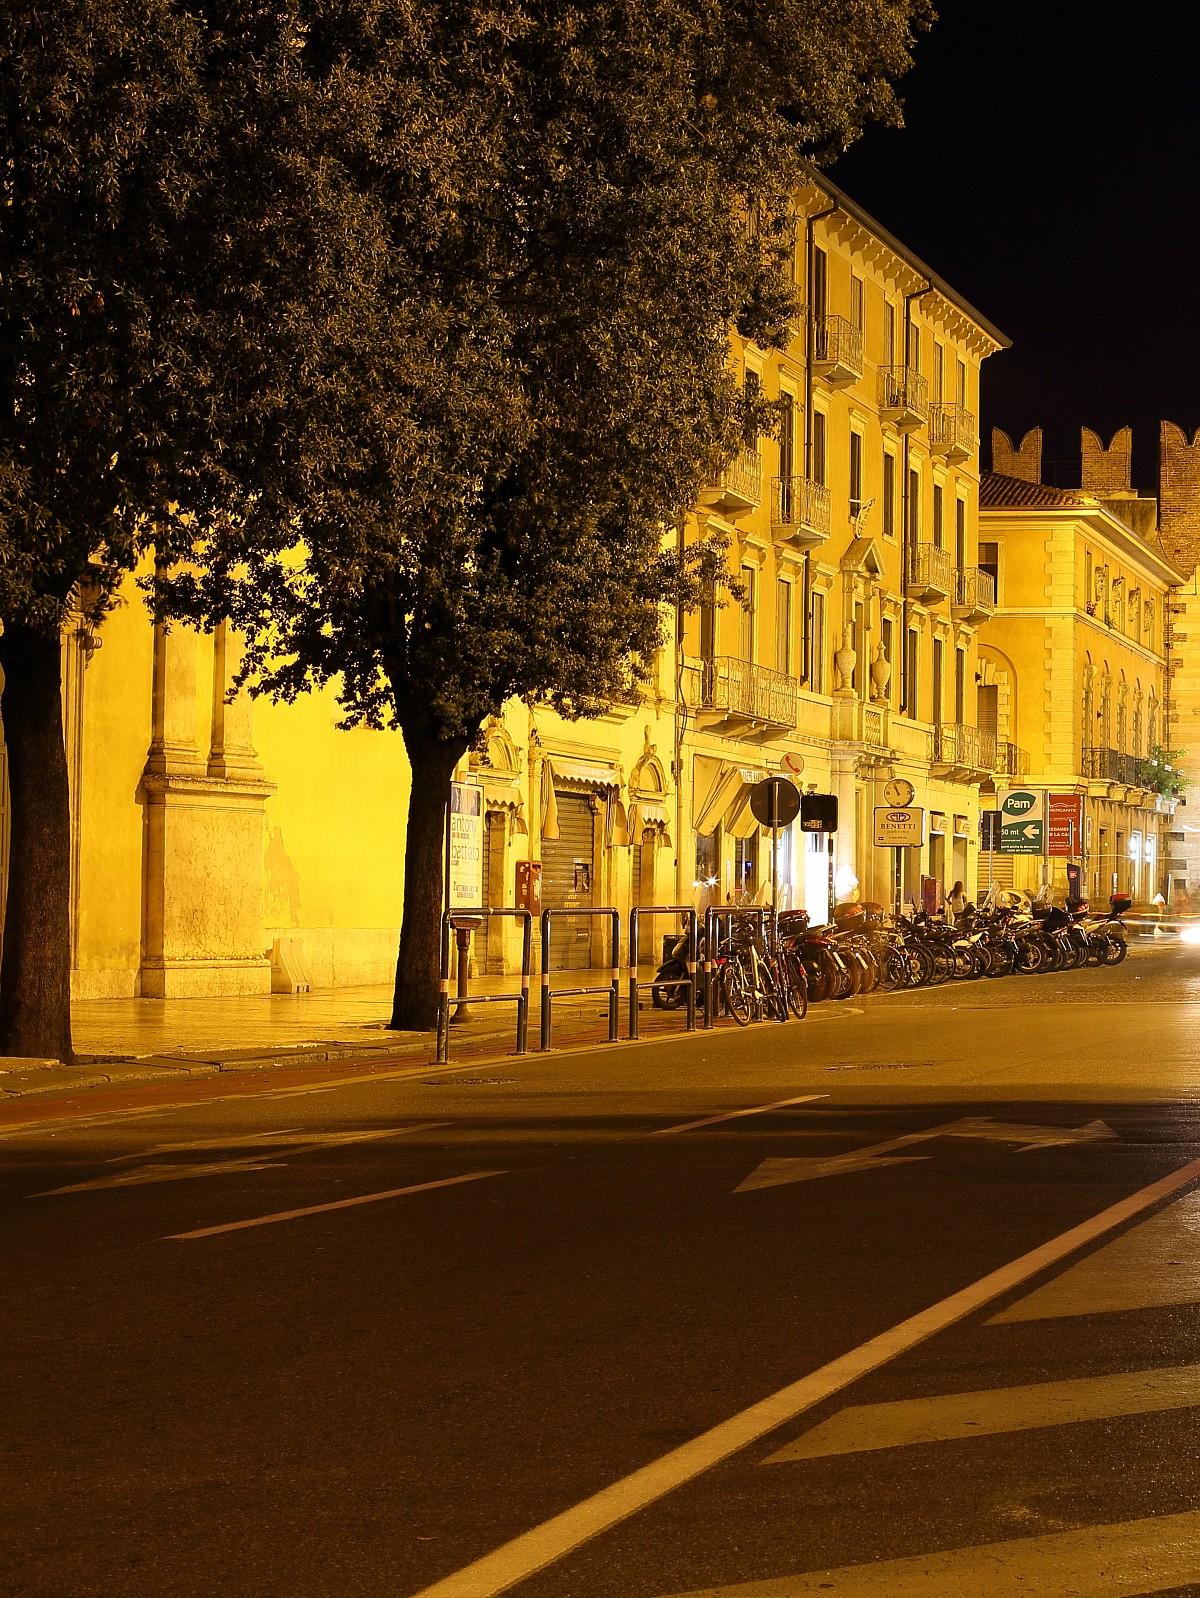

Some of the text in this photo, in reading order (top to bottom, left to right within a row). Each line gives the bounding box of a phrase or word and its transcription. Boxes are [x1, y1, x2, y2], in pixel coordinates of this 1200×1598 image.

[1007, 798, 1031, 809] Pam
[451, 816, 478, 839] antony
[451, 838, 480, 862] battiato
